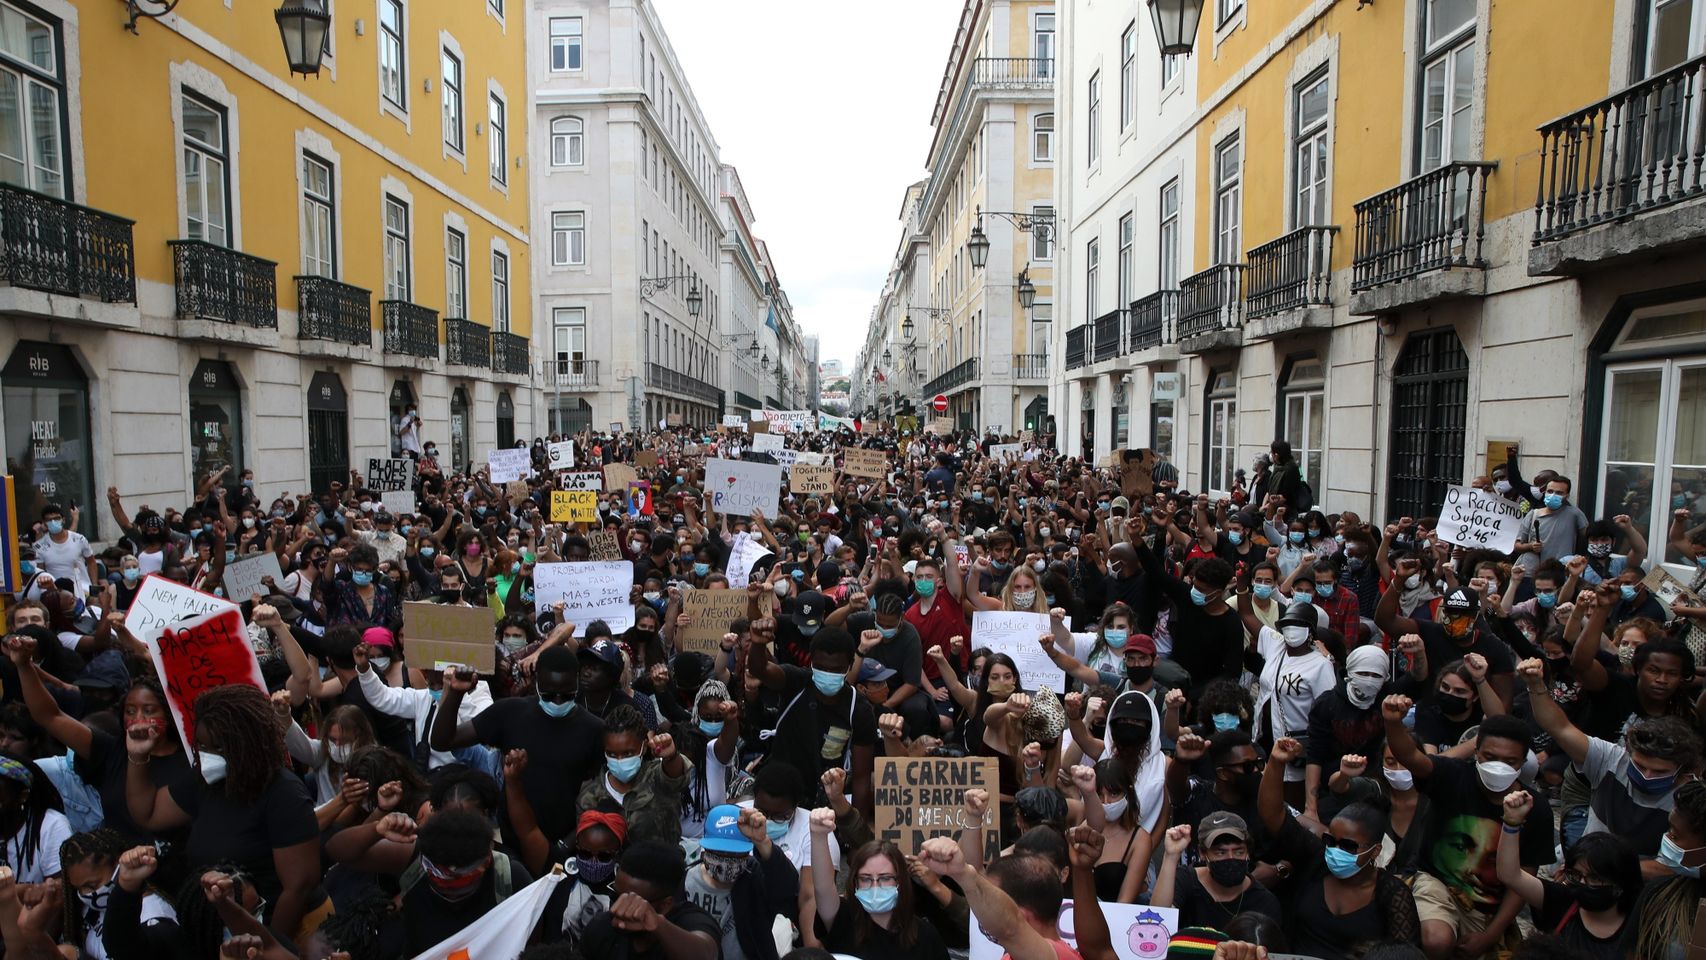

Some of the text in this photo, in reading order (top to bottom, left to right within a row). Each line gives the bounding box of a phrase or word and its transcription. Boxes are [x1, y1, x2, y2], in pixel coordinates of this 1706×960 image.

[30, 352, 50, 370] RIB
[203, 369, 217, 383] RIB
[32, 421, 54, 440] MEAT
[34, 442, 57, 459] friends
[369, 459, 408, 473] BLACK
[368, 470, 407, 482] LIVES
[574, 473, 602, 481] ALMA
[39, 477, 57, 493] RIB
[367, 480, 406, 492] MATTER
[563, 480, 586, 489] NÃO
[800, 483, 828, 491] STAND
[554, 493, 592, 504] BLACK
[714, 491, 771, 508] RACISMO
[1447, 488, 1522, 520] O Racismo
[1451, 505, 1502, 530] Sufoca
[552, 565, 596, 576] PROBLEMA
[588, 576, 615, 585] FARDA
[151, 588, 178, 604] NEM
[562, 587, 619, 600] MAS SIM
[596, 596, 624, 608] VESTE
[701, 605, 742, 619] NEGROS
[976, 615, 1029, 632] Injustice
[155, 617, 233, 658] PAREM
[165, 668, 227, 697] NOS
[1279, 672, 1304, 696] NY
[881, 760, 985, 786] A CARNE
[718, 815, 736, 824] NIKE
[895, 806, 913, 827] DO
